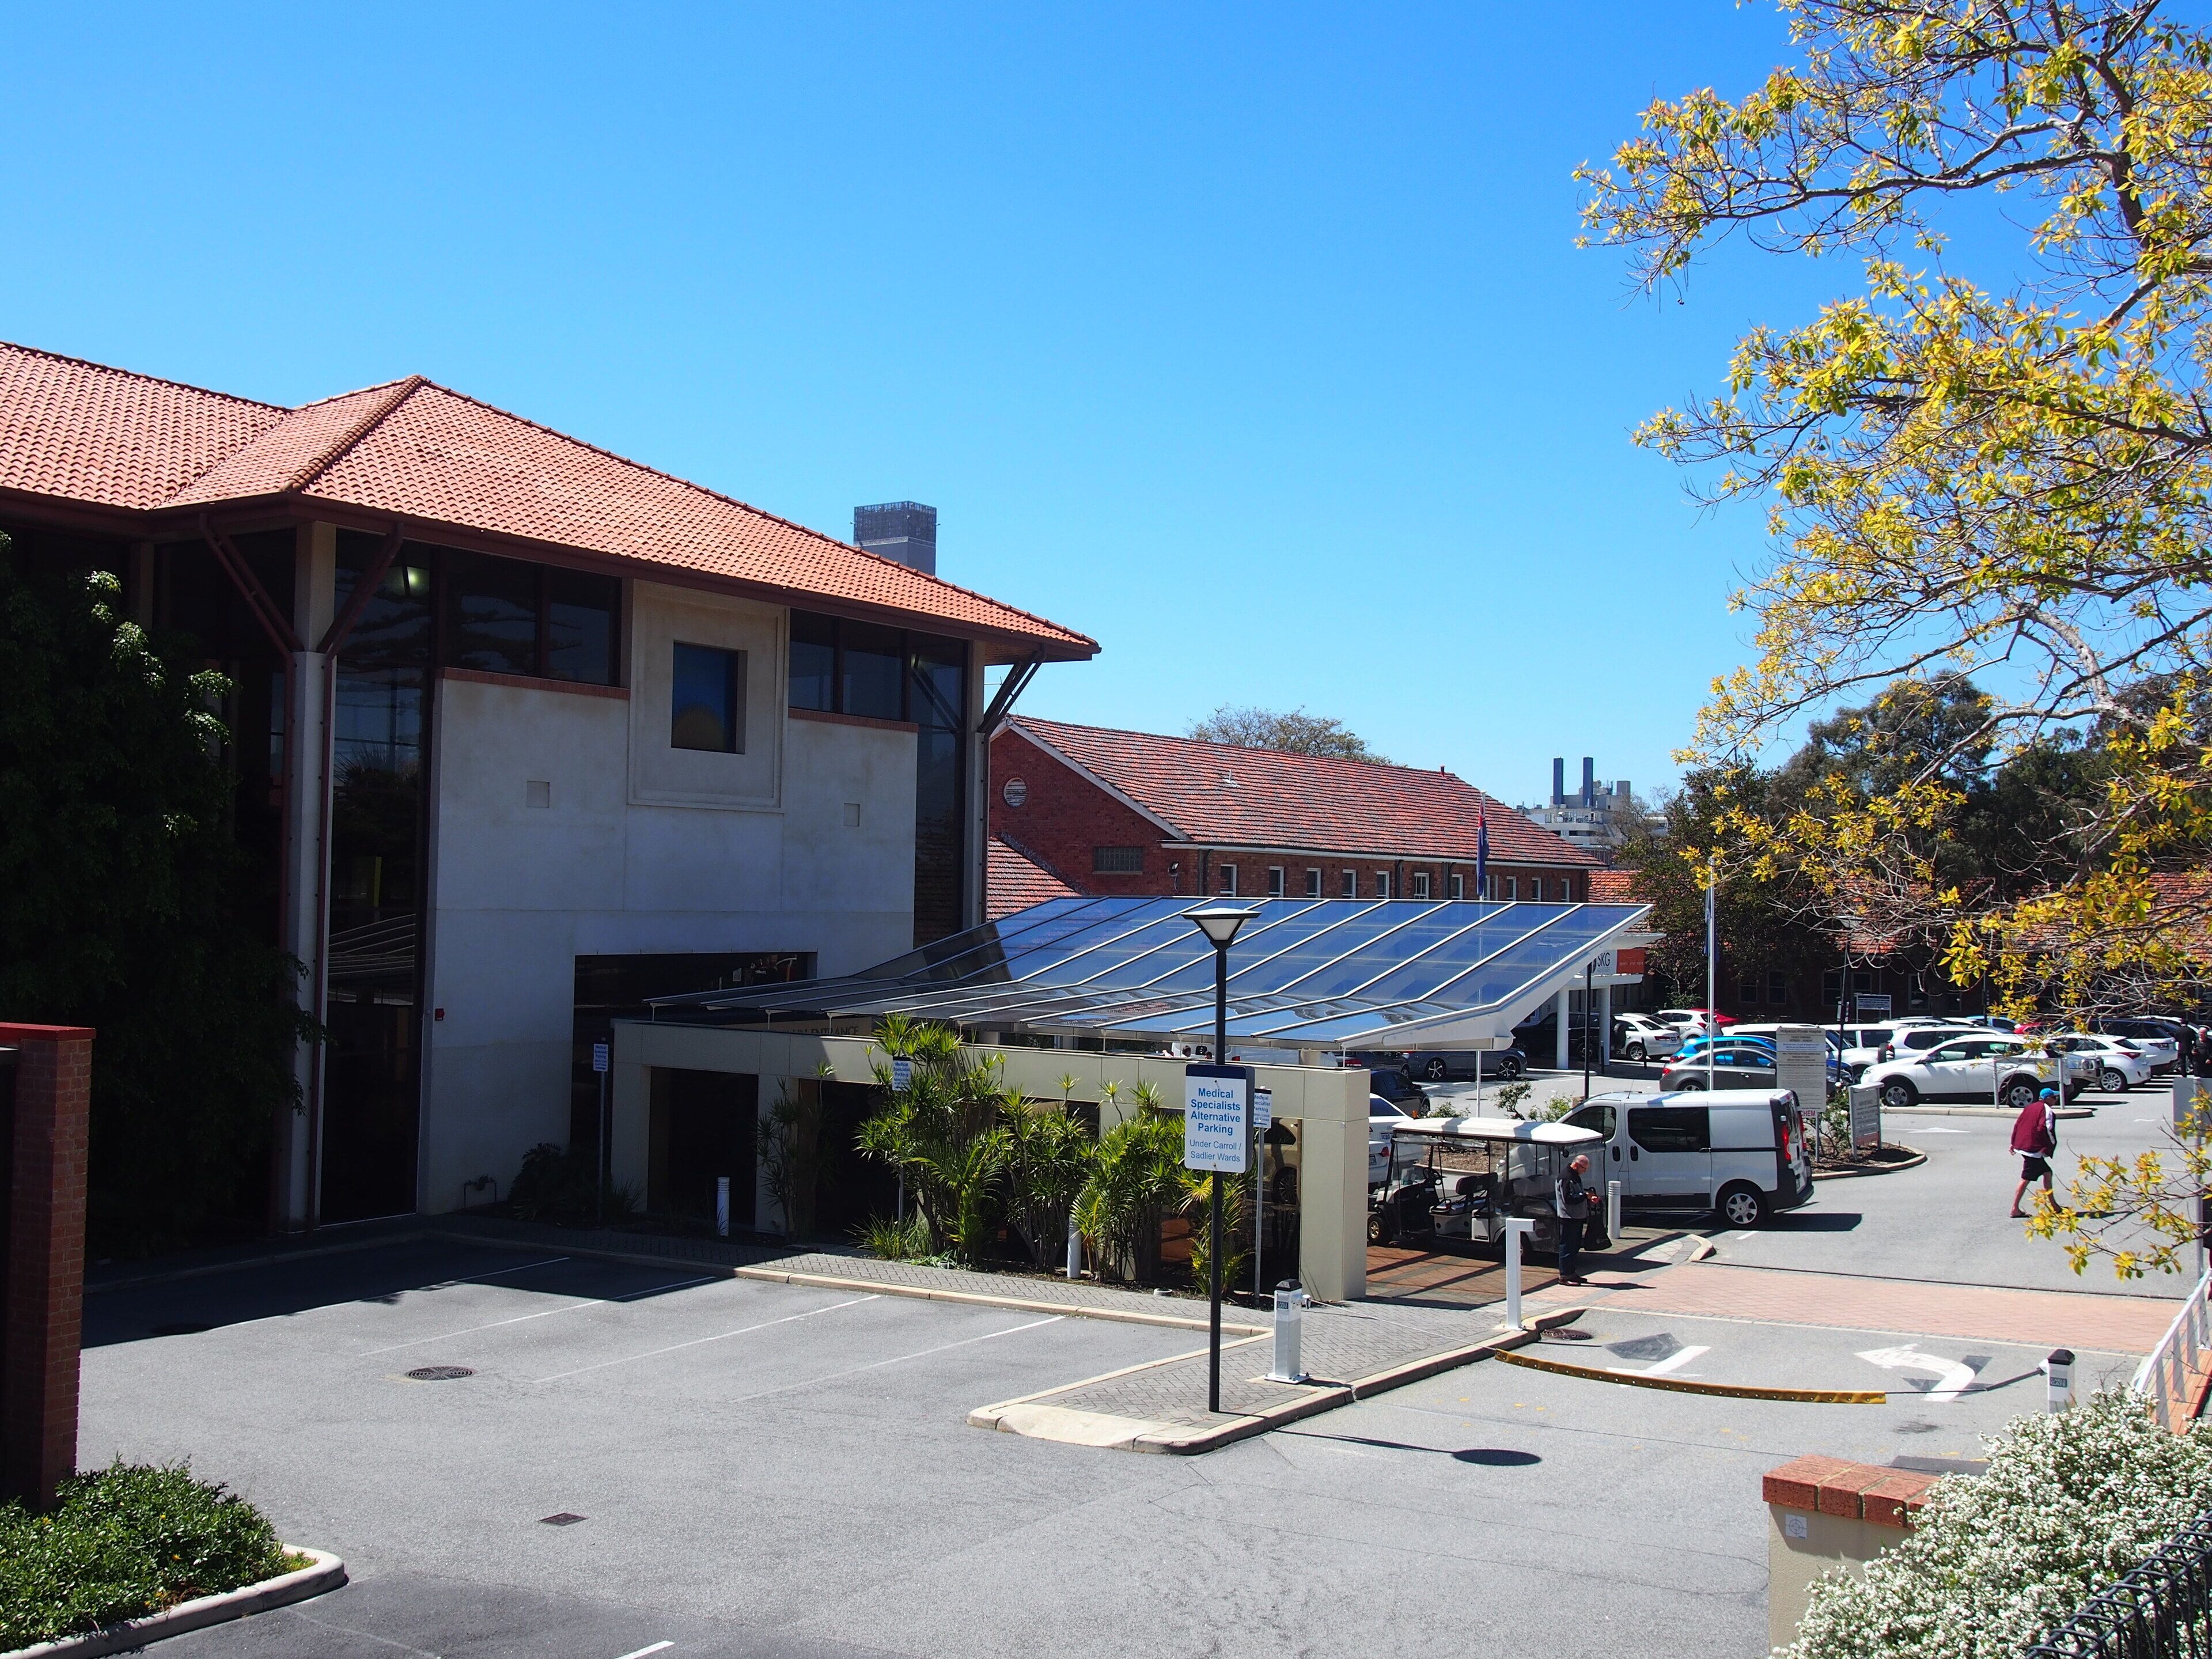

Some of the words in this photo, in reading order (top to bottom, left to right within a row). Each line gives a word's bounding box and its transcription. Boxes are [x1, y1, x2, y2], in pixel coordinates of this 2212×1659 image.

[1597, 952, 1610, 967] SKG
[1198, 1088, 1233, 1099] Medical
[1191, 1099, 1240, 1111] Specialists
[1191, 1111, 1240, 1123] Alternative
[1198, 1123, 1233, 1136] Parking
[1190, 1139, 1211, 1148] Under
[1213, 1141, 1237, 1150] Carroll
[1238, 1142, 1242, 1150] /
[1190, 1151, 1215, 1160] Sadlier
[1217, 1153, 1240, 1162] Wards
